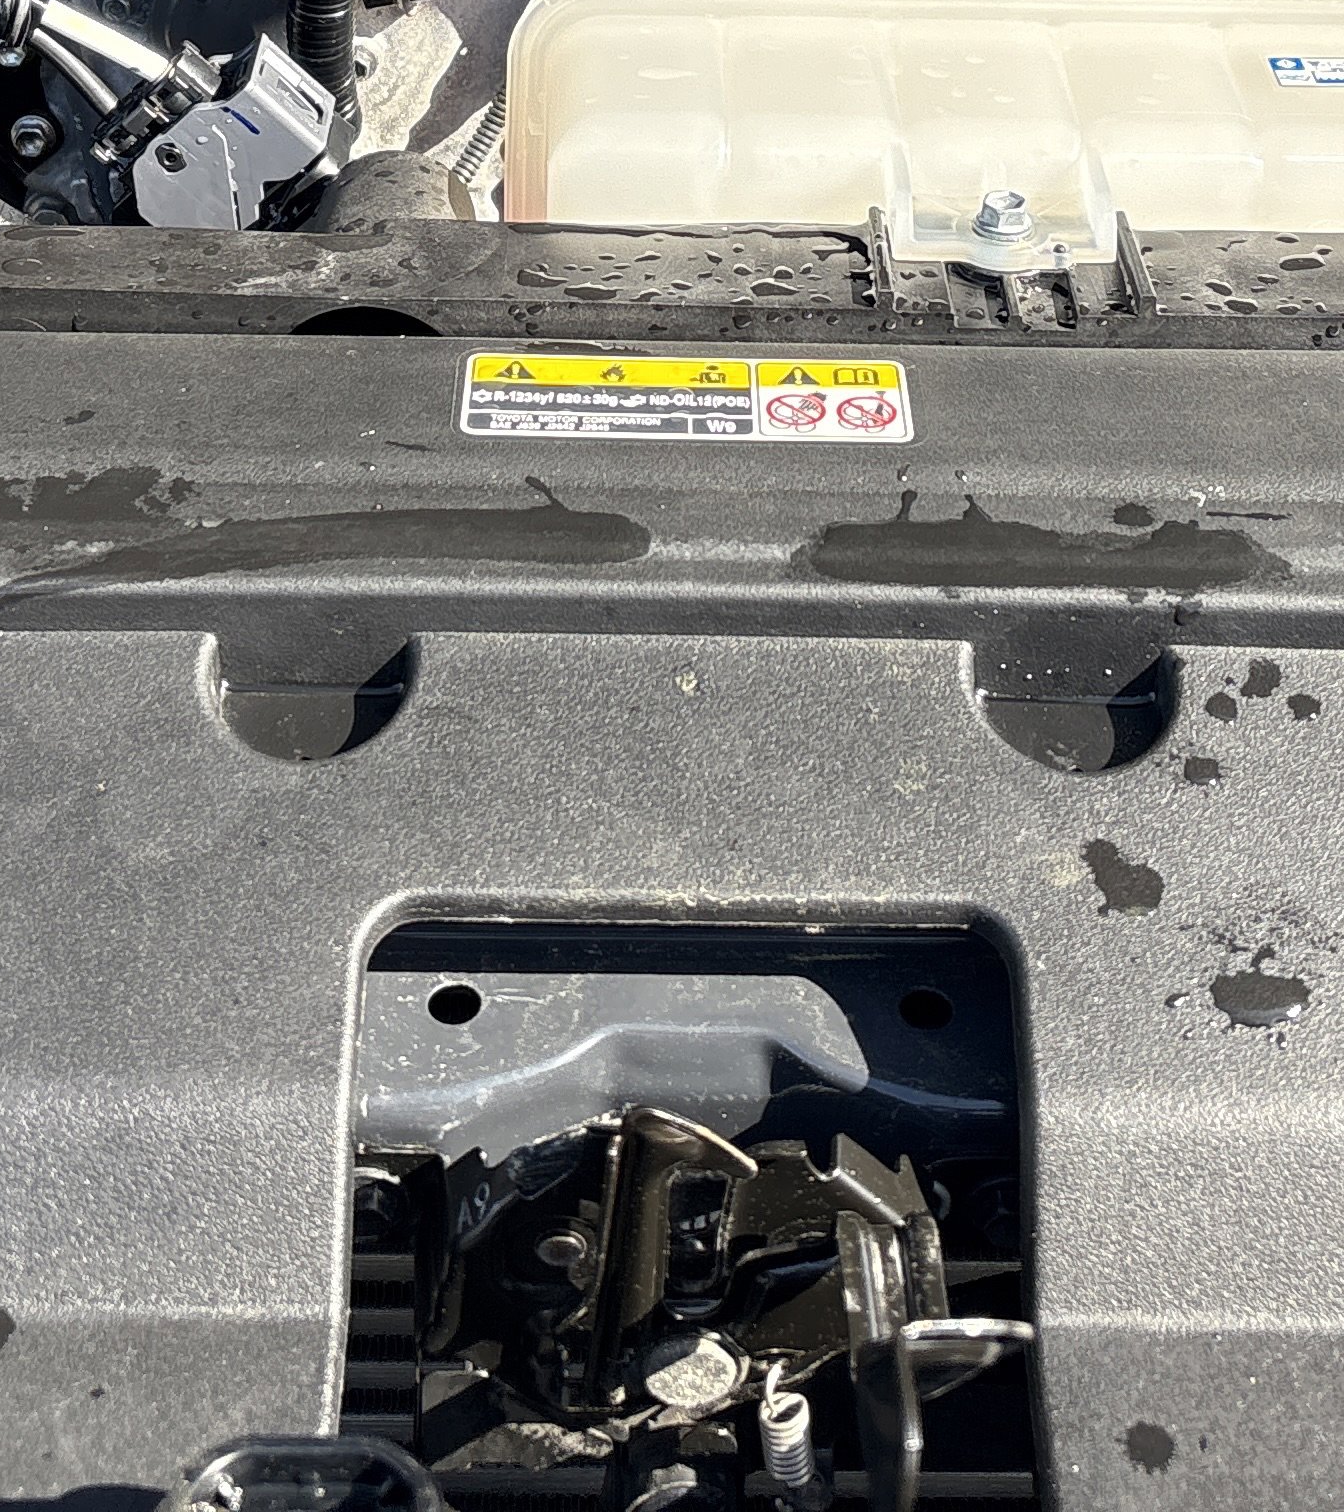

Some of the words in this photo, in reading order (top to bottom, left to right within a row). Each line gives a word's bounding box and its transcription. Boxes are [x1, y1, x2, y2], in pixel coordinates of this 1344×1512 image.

[490, 414, 534, 423] TOYOTA
[537, 415, 579, 424] MOTOR
[581, 416, 662, 427] CORPORATION
